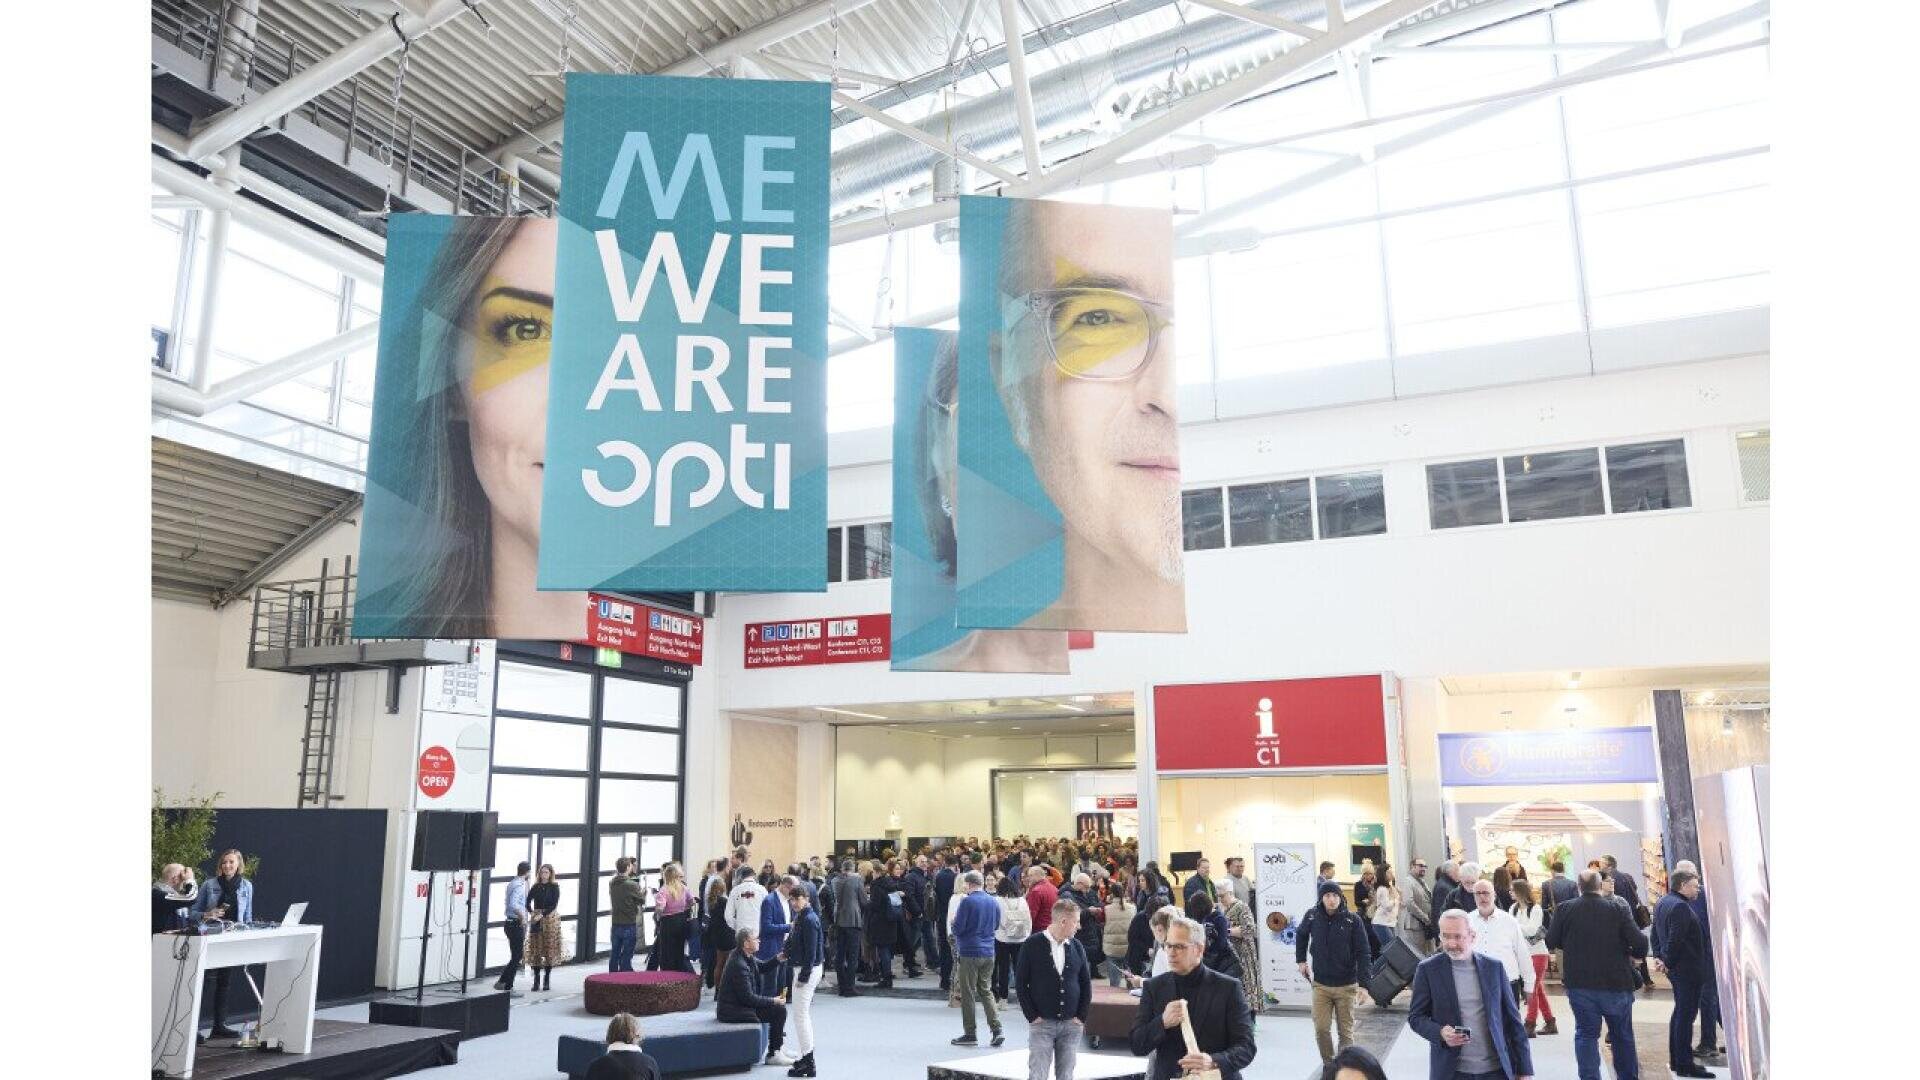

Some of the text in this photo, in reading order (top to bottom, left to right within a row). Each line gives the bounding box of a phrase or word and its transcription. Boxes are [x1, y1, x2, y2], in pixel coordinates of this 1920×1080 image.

[595, 131, 796, 223] ME
[594, 229, 795, 325] WE
[585, 333, 793, 413] ARE
[581, 423, 792, 527] opti
[597, 622, 623, 636] Ausgang
[648, 632, 673, 647] Ausgang
[748, 642, 821, 656] Ausgang Nord-West
[747, 654, 804, 664] Exit North-West
[1256, 748, 1280, 766] C1
[422, 776, 449, 787] OPEN
